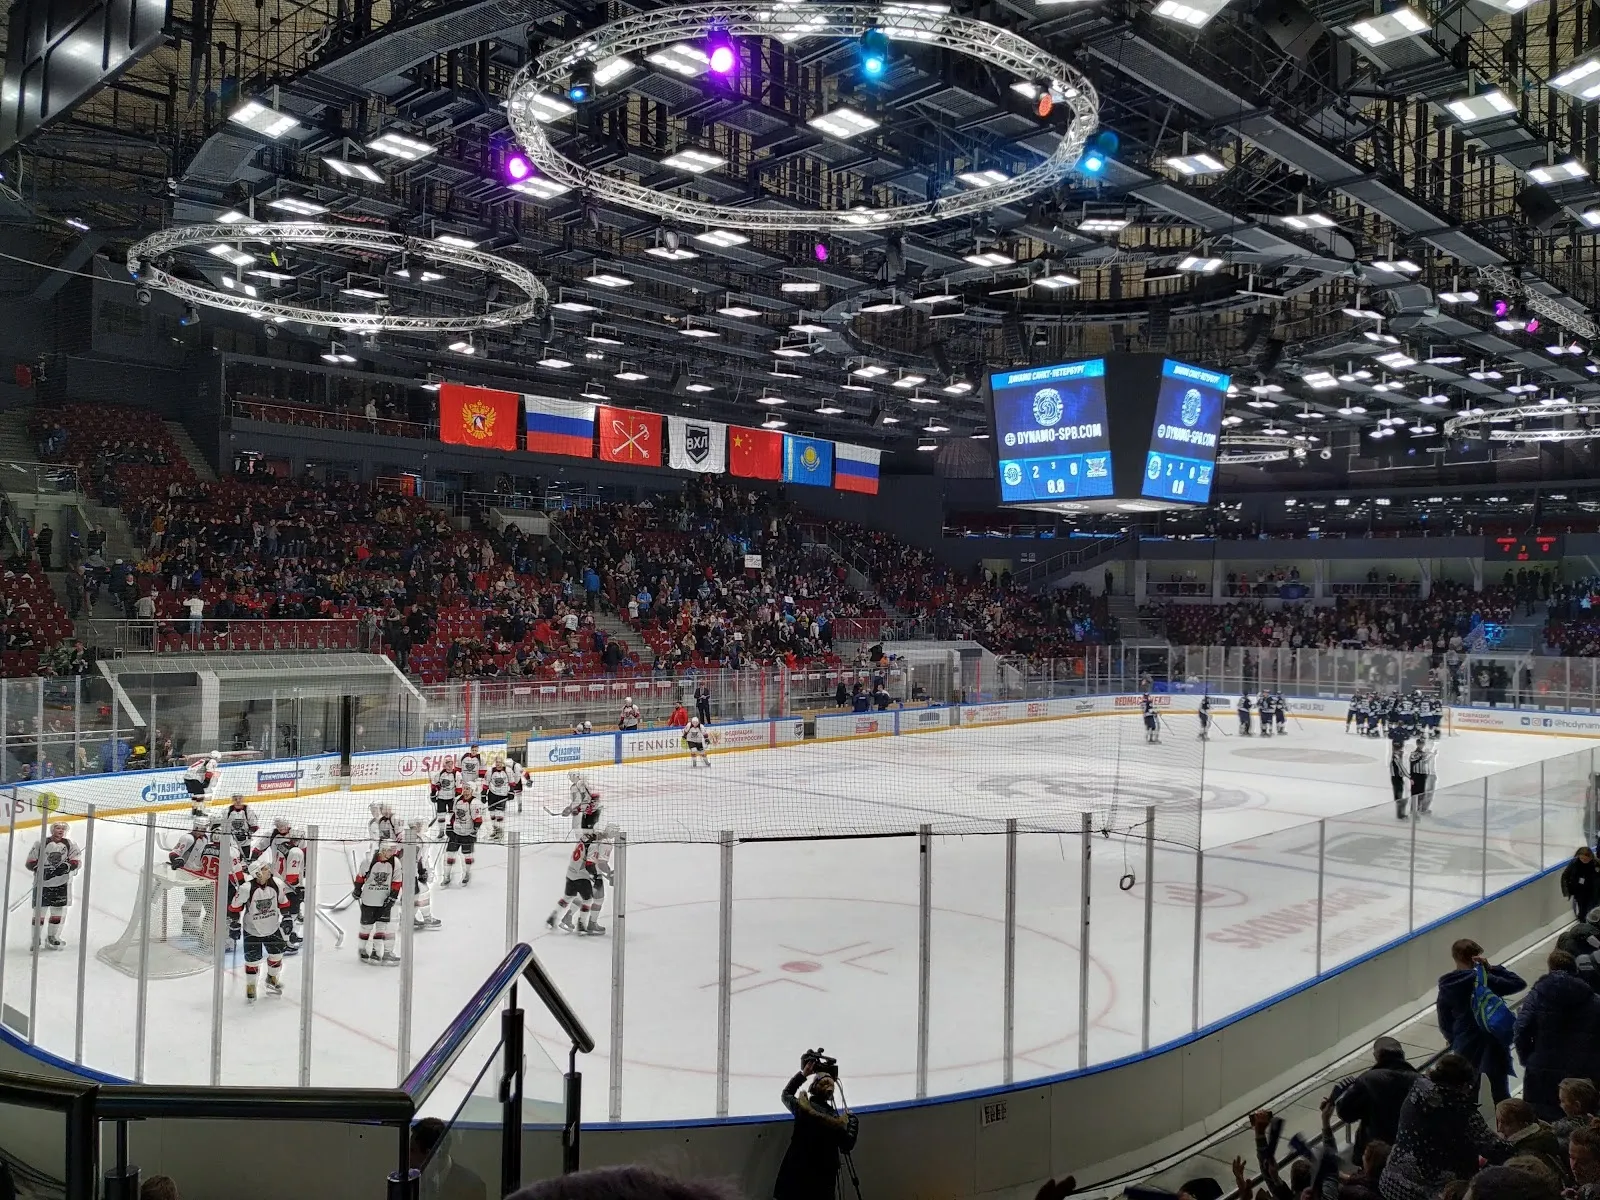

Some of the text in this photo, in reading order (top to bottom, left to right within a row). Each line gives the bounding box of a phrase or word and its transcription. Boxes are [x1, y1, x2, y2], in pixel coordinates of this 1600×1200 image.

[1017, 423, 1103, 445] DYNAMO-SPB.COM
[1165, 425, 1216, 447] DYNAMO-SPB.COM
[687, 436, 708, 450] ВХЛ
[1032, 465, 1040, 478] 2
[629, 738, 679, 752] TENNISI
[158, 782, 187, 793] ГАЗПРО
[202, 856, 220, 877] 35
